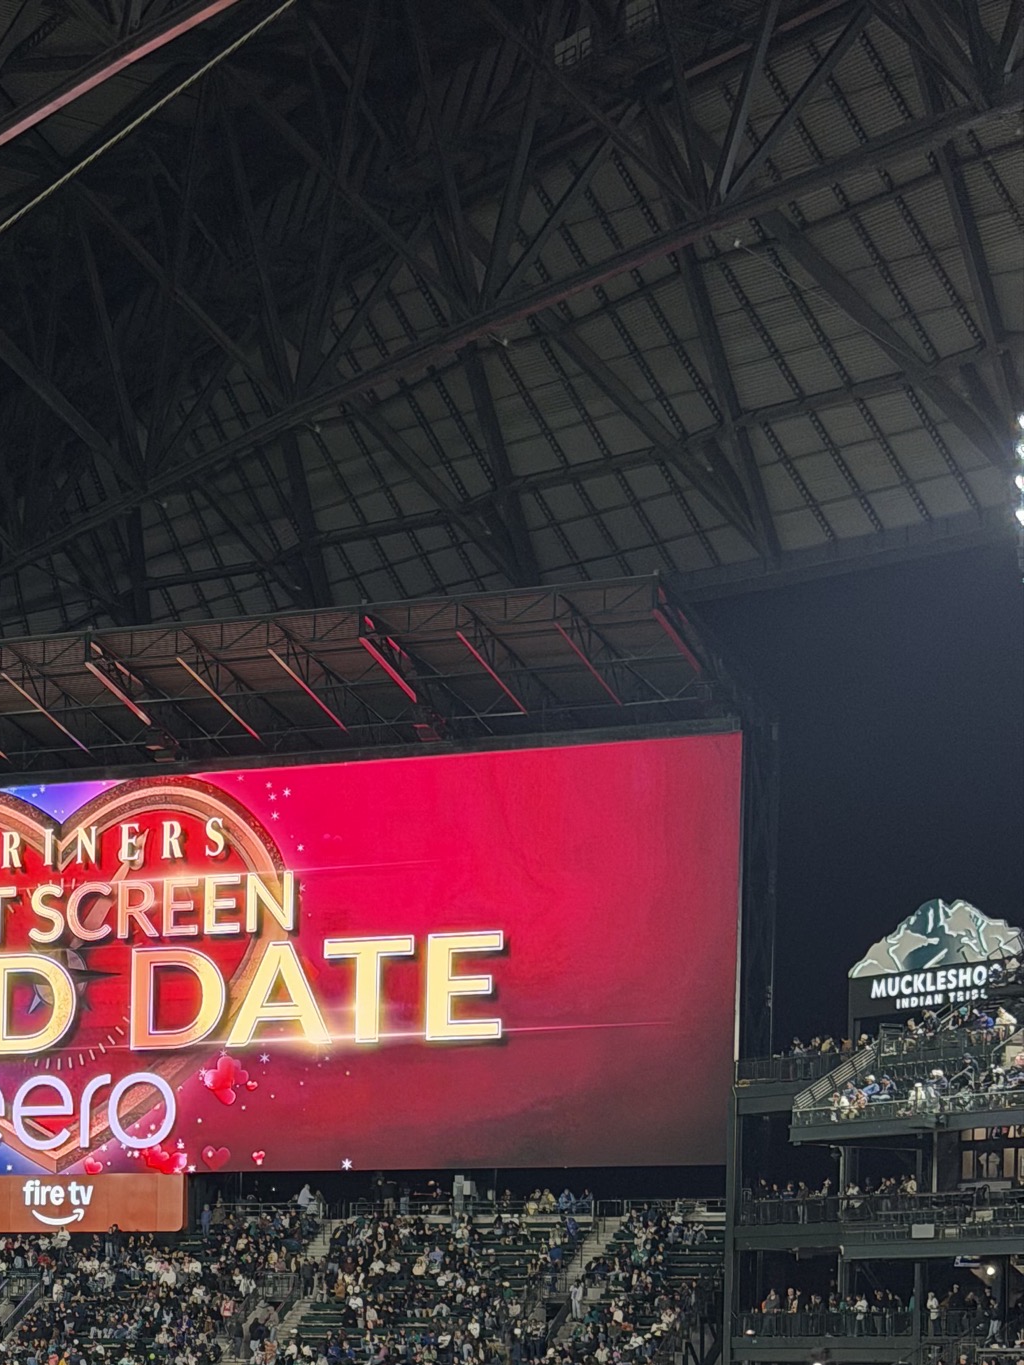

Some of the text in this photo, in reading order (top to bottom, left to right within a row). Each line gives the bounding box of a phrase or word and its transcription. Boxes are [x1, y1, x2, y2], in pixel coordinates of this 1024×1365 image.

[28, 870, 296, 943] SCREEN
[129, 930, 504, 1051] DATE
[871, 963, 1002, 999] MUCKLESHOO
[896, 993, 944, 1009] INDIAN
[22, 1179, 94, 1206] fire tv
